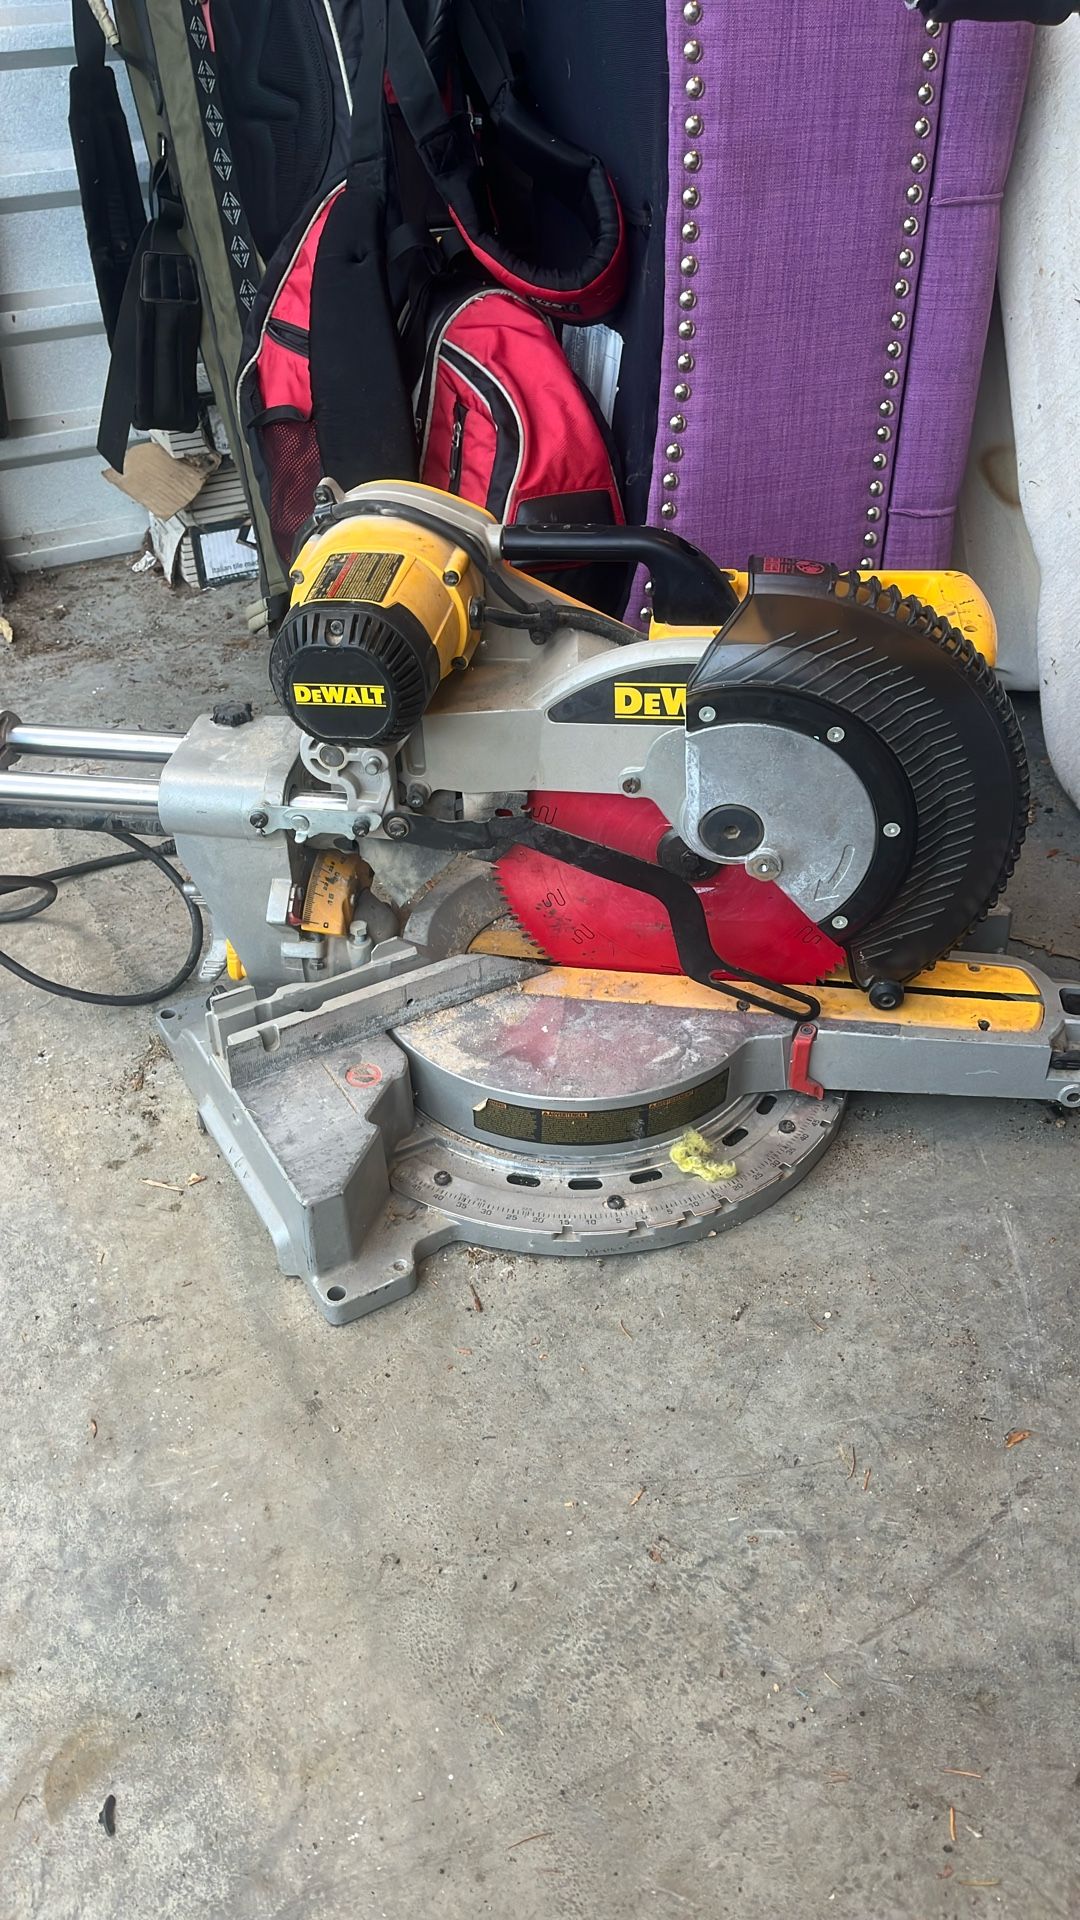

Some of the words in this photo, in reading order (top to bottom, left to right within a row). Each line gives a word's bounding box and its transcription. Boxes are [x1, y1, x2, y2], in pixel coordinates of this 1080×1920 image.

[212, 563, 233, 574] Italian
[233, 561, 243, 569] tile
[433, 1193, 444, 1201] 40
[455, 1201, 467, 1209] 35
[480, 1208, 492, 1216] 30
[505, 1213, 518, 1221] 25
[532, 1216, 545, 1224] 20
[710, 1192, 722, 1200] 15
[732, 1183, 743, 1191] 20
[752, 1173, 763, 1181] 25
[769, 1159, 781, 1168] 30
